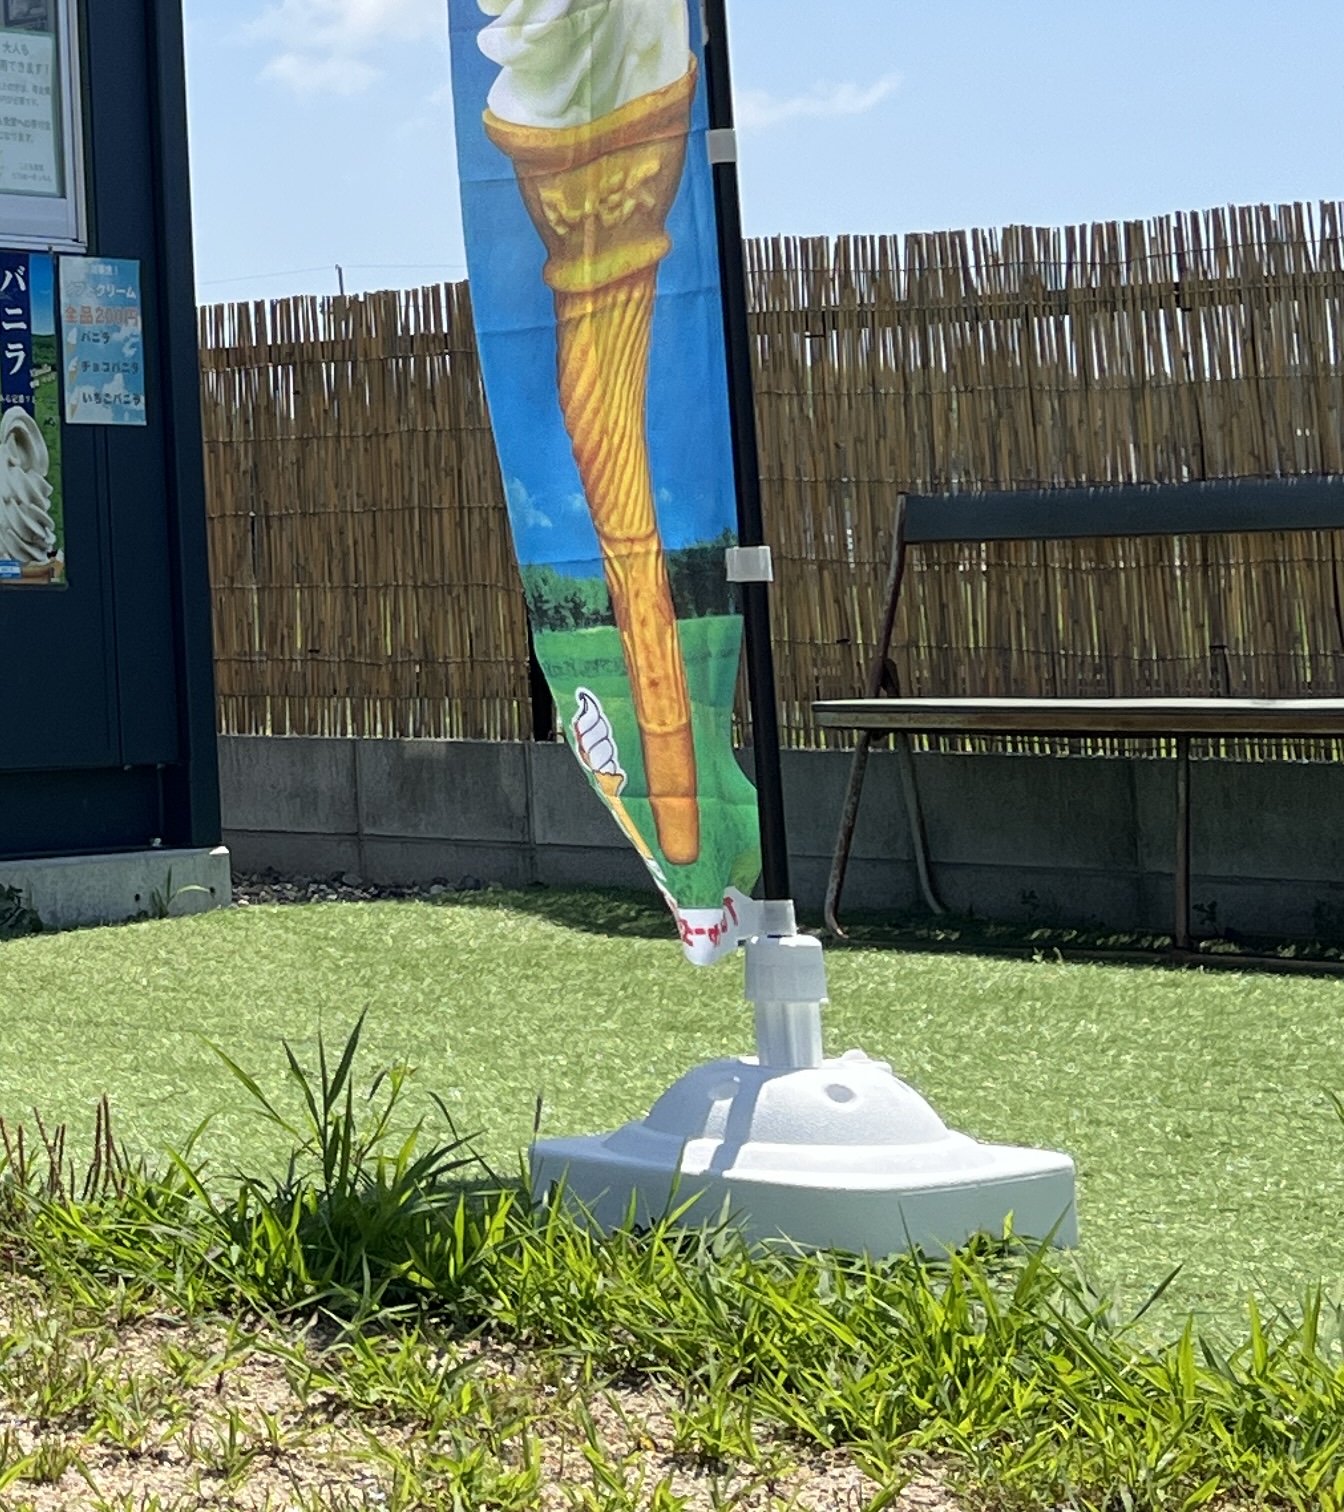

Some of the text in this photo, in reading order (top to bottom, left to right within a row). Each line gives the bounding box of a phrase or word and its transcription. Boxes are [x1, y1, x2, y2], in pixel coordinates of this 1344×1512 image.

[0, 265, 28, 376] バニラ
[65, 305, 140, 327] 全品200円
[80, 330, 111, 345] バニラ
[80, 360, 140, 374] チョコバニラ
